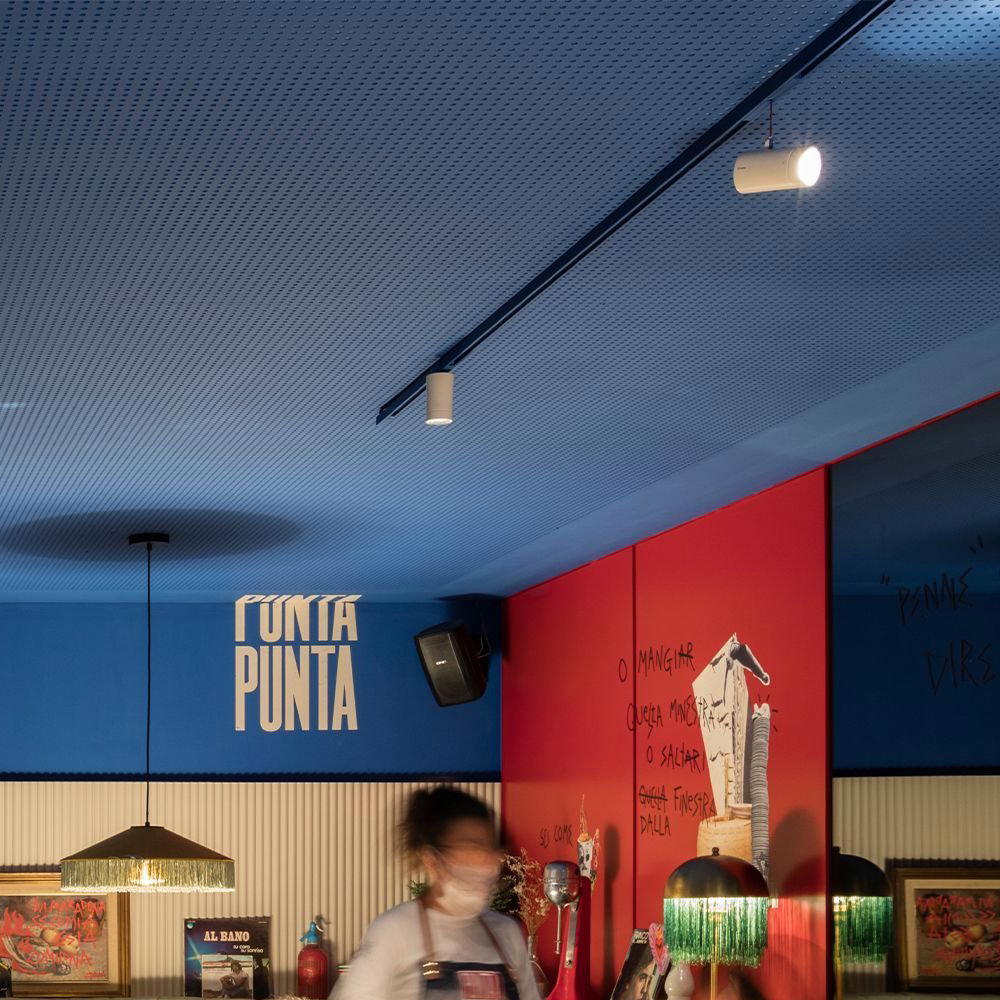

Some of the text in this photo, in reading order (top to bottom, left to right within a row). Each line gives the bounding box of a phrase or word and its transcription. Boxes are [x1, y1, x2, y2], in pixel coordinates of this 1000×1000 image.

[235, 594, 362, 642] PUNTA
[618, 642, 695, 683] O MANGIAR
[235, 645, 358, 732] PUNTA
[646, 745, 653, 764] O
[640, 813, 671, 837] DALLA
[203, 931, 250, 942] AL BANO
